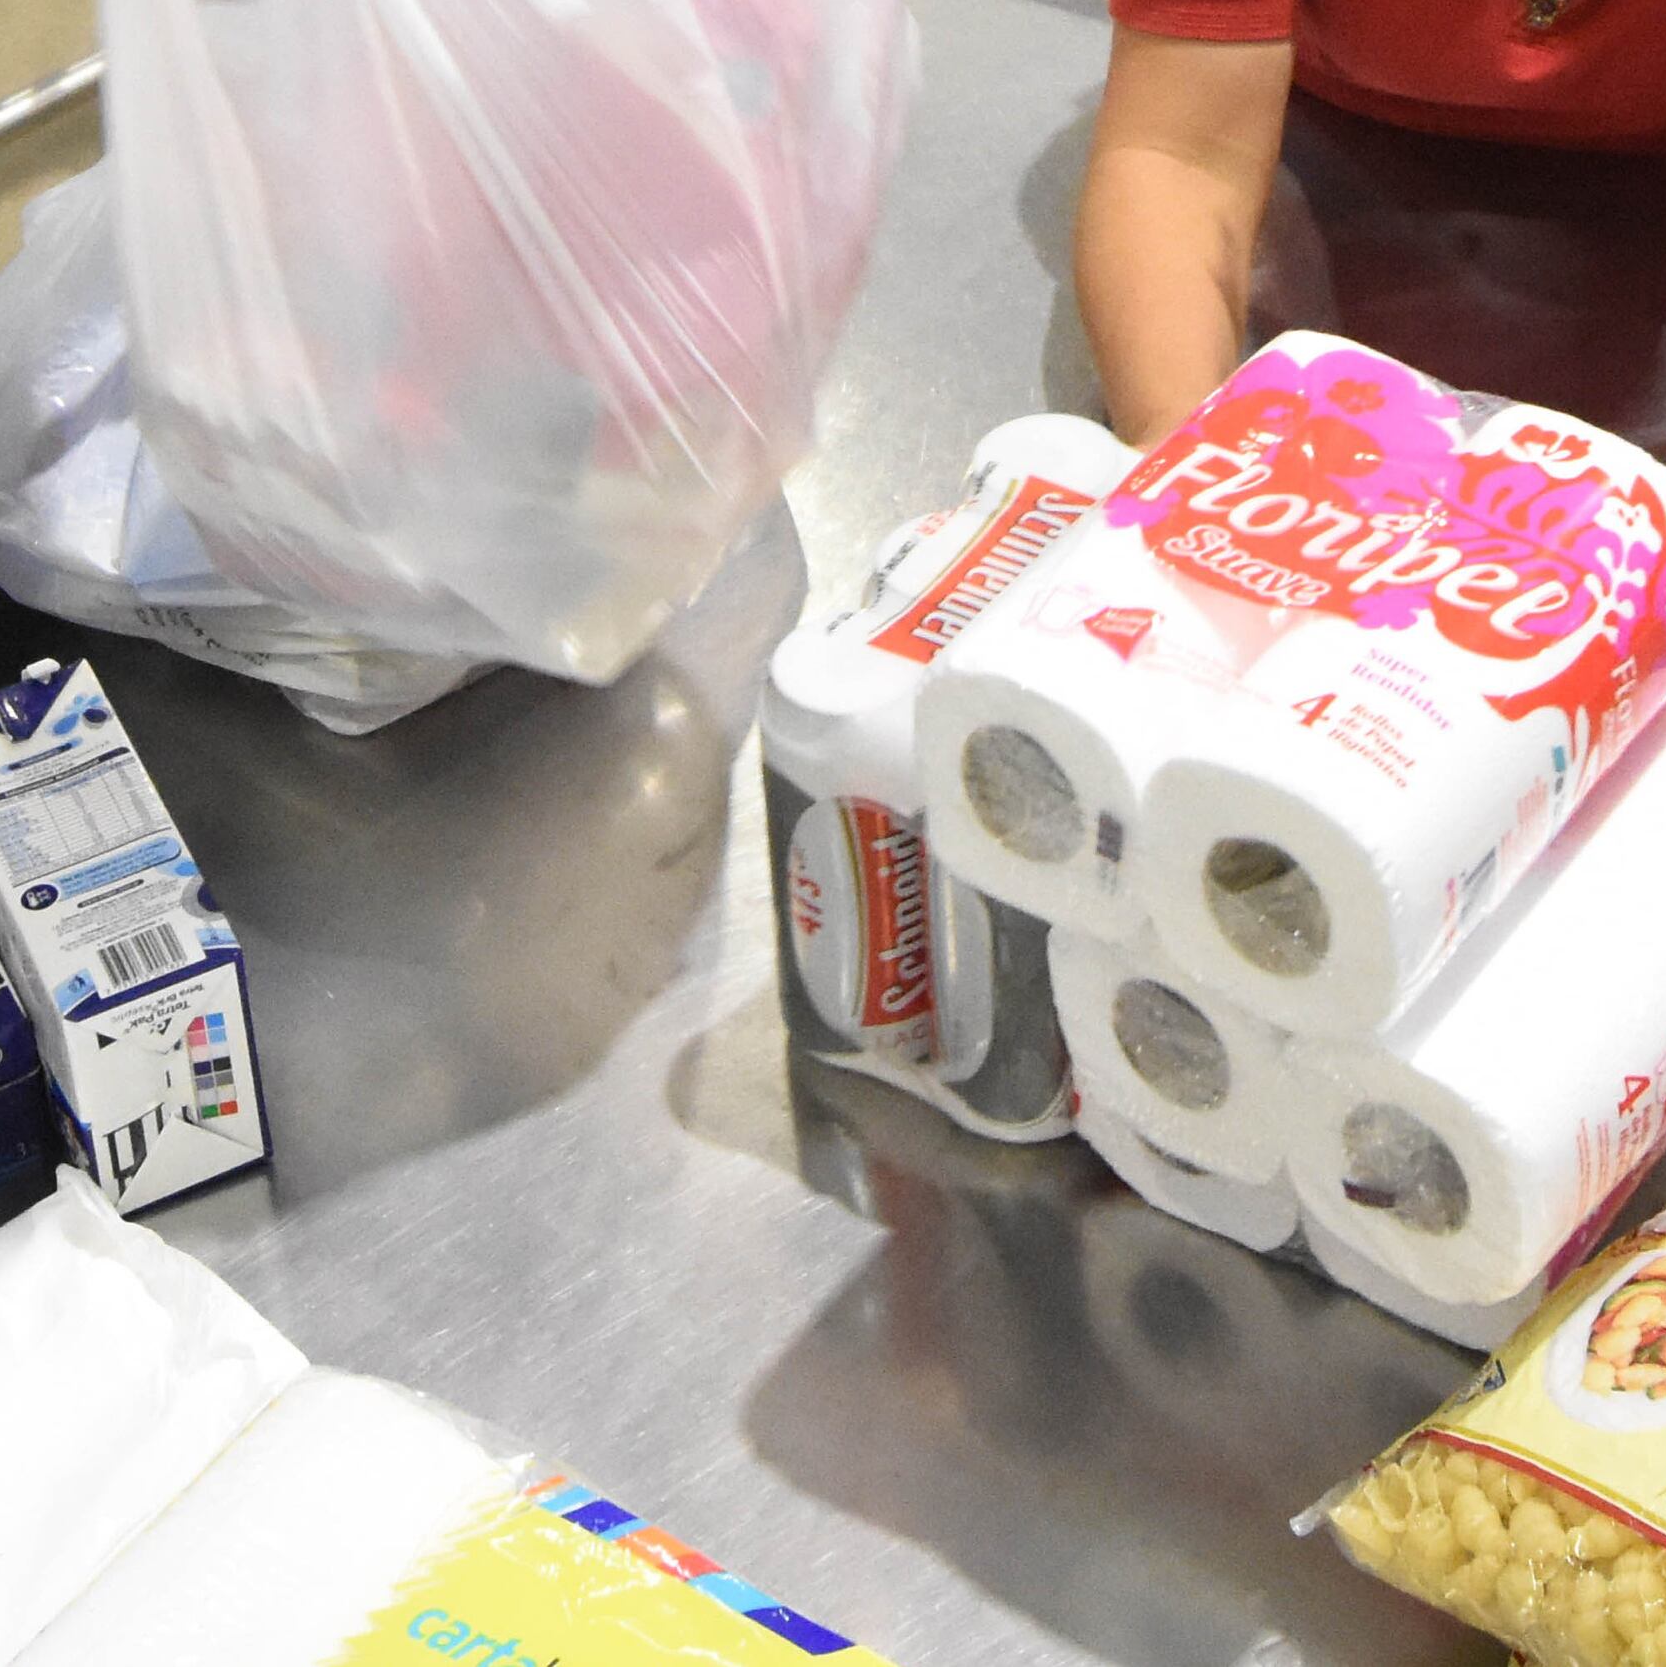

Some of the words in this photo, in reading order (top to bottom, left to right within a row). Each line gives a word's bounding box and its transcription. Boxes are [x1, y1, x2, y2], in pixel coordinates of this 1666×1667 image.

[1140, 440, 1569, 642] Floripel
[1165, 523, 1331, 607] Suave
[1291, 692, 1339, 729] 4
[1616, 1073, 1651, 1119] 4
